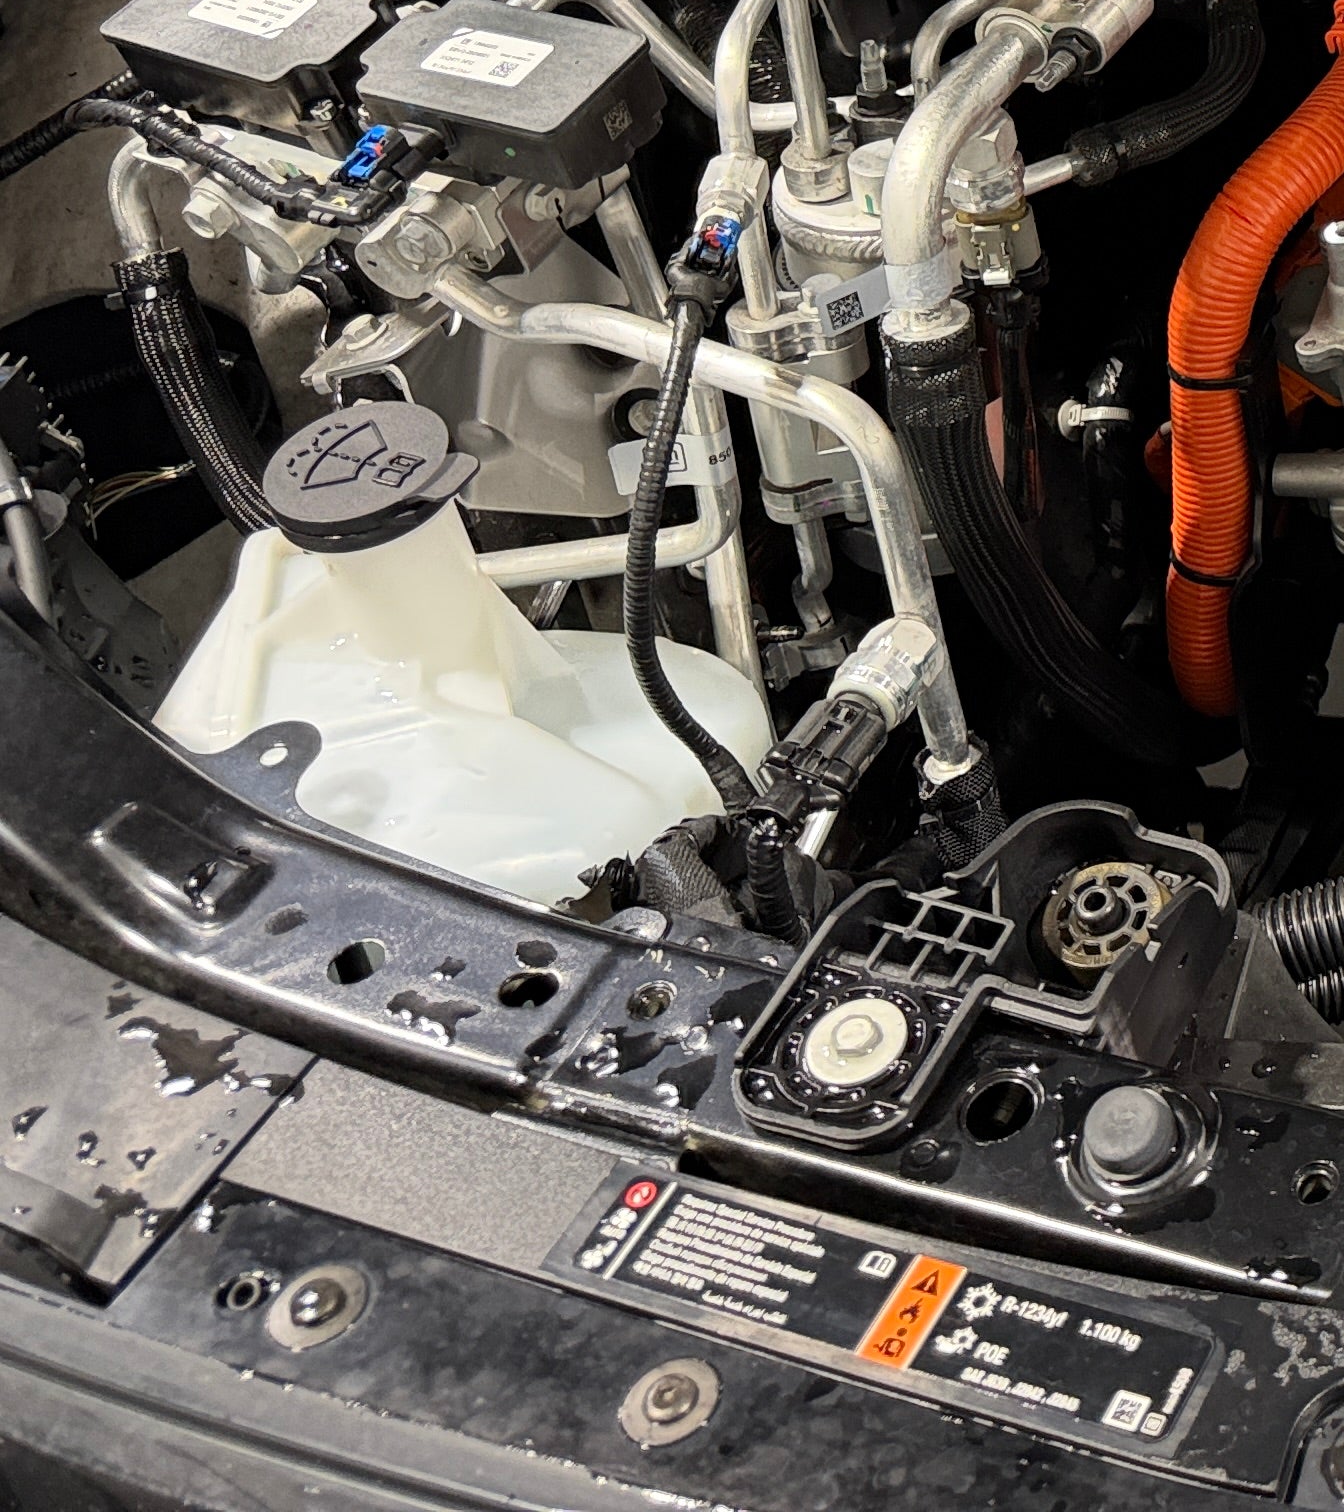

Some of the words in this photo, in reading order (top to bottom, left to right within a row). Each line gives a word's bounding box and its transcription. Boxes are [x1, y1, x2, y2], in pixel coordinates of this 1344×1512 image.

[1000, 1296, 1069, 1329] R-1234yf
[1078, 1318, 1120, 1345] 1.100
[1118, 1331, 1143, 1352] kg
[973, 1342, 1010, 1366] POE
